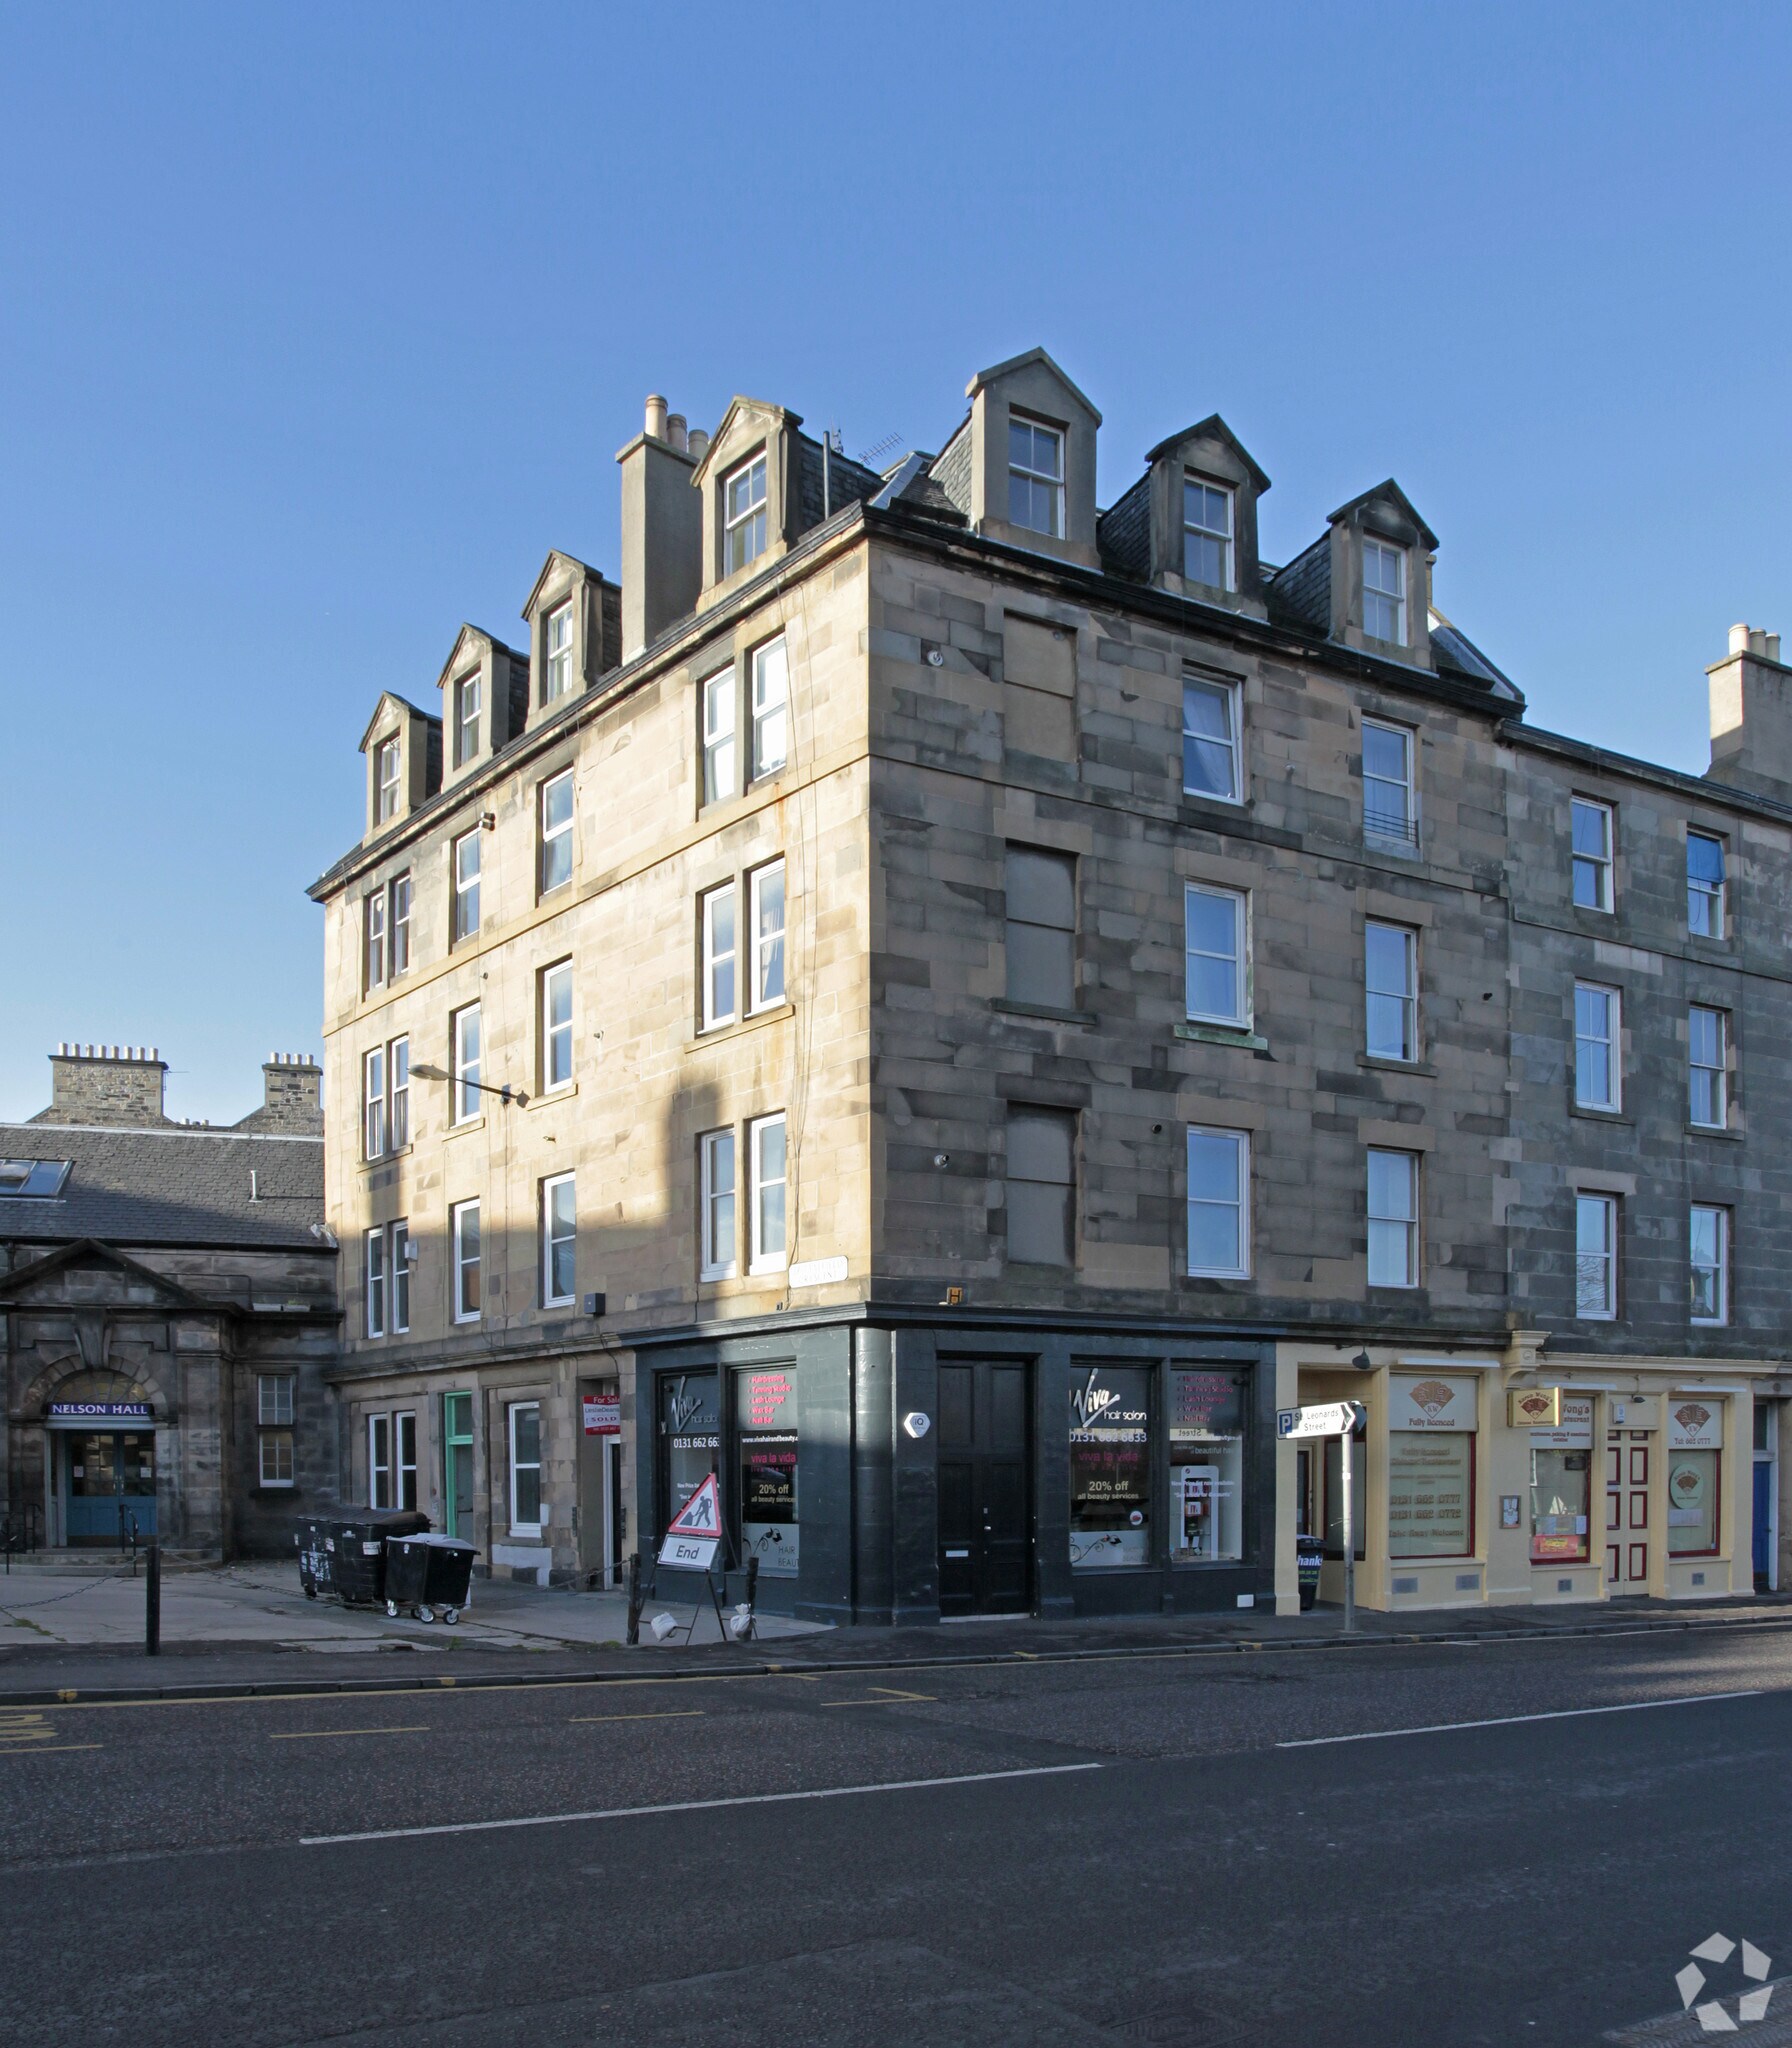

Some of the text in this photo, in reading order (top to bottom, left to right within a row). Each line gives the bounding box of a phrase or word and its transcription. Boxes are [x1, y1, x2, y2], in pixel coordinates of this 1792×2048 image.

[593, 1396, 605, 1404] For
[1073, 1367, 1121, 1428] Viva
[52, 1404, 148, 1415] NELSON HALL
[670, 1375, 702, 1434] Viva
[704, 1414, 718, 1423] salo
[1103, 1409, 1147, 1421] hair salon
[1306, 1408, 1340, 1421] Leonards
[1281, 1414, 1291, 1434] P
[1303, 1422, 1327, 1432] Street
[1408, 1418, 1425, 1427] Fully
[673, 1437, 692, 1449] 0131
[692, 1436, 707, 1448] 662
[1195, 1446, 1222, 1454] beautiful
[751, 1452, 797, 1464] viva la vida
[1078, 1453, 1101, 1462] viva
[1103, 1451, 1113, 1462] la
[758, 1484, 789, 1494] 20% off
[1089, 1480, 1129, 1491] 20% off
[758, 1496, 776, 1504] beauty
[1087, 1493, 1110, 1501] beauty
[675, 1544, 700, 1560] End
[778, 1545, 796, 1554] HAIR
[777, 1557, 800, 1568] BEAUT
[1298, 1554, 1323, 1567] hank
